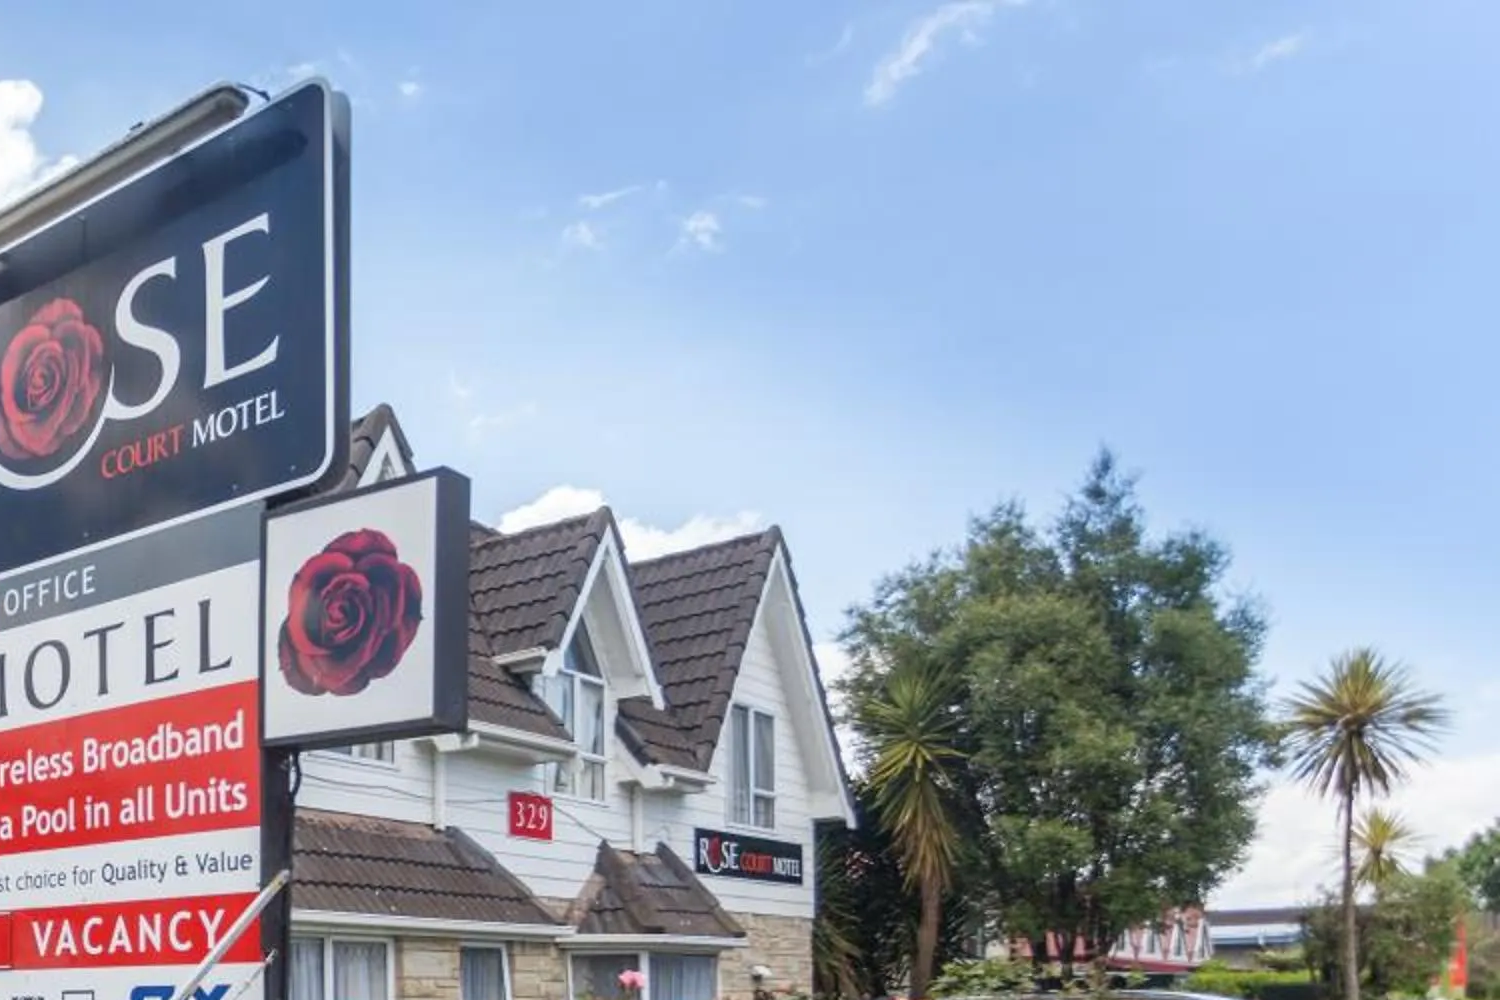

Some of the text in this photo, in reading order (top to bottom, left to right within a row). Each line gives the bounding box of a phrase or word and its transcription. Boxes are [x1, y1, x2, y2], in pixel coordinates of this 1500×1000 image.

[101, 390, 285, 479] COURT MOTEL
[3, 565, 97, 616] OFFICE
[83, 709, 244, 773] Broadband
[22, 797, 75, 837] Pool
[85, 795, 110, 830] in
[119, 785, 153, 824] all
[165, 777, 247, 818] Units
[515, 801, 547, 830] 329
[16, 868, 66, 891] choice
[73, 866, 96, 885] for
[101, 859, 167, 884] Quality
[175, 856, 188, 876] &
[196, 851, 253, 873] Value
[772, 856, 801, 877] MOTEL
[32, 908, 225, 957] VACANCY
